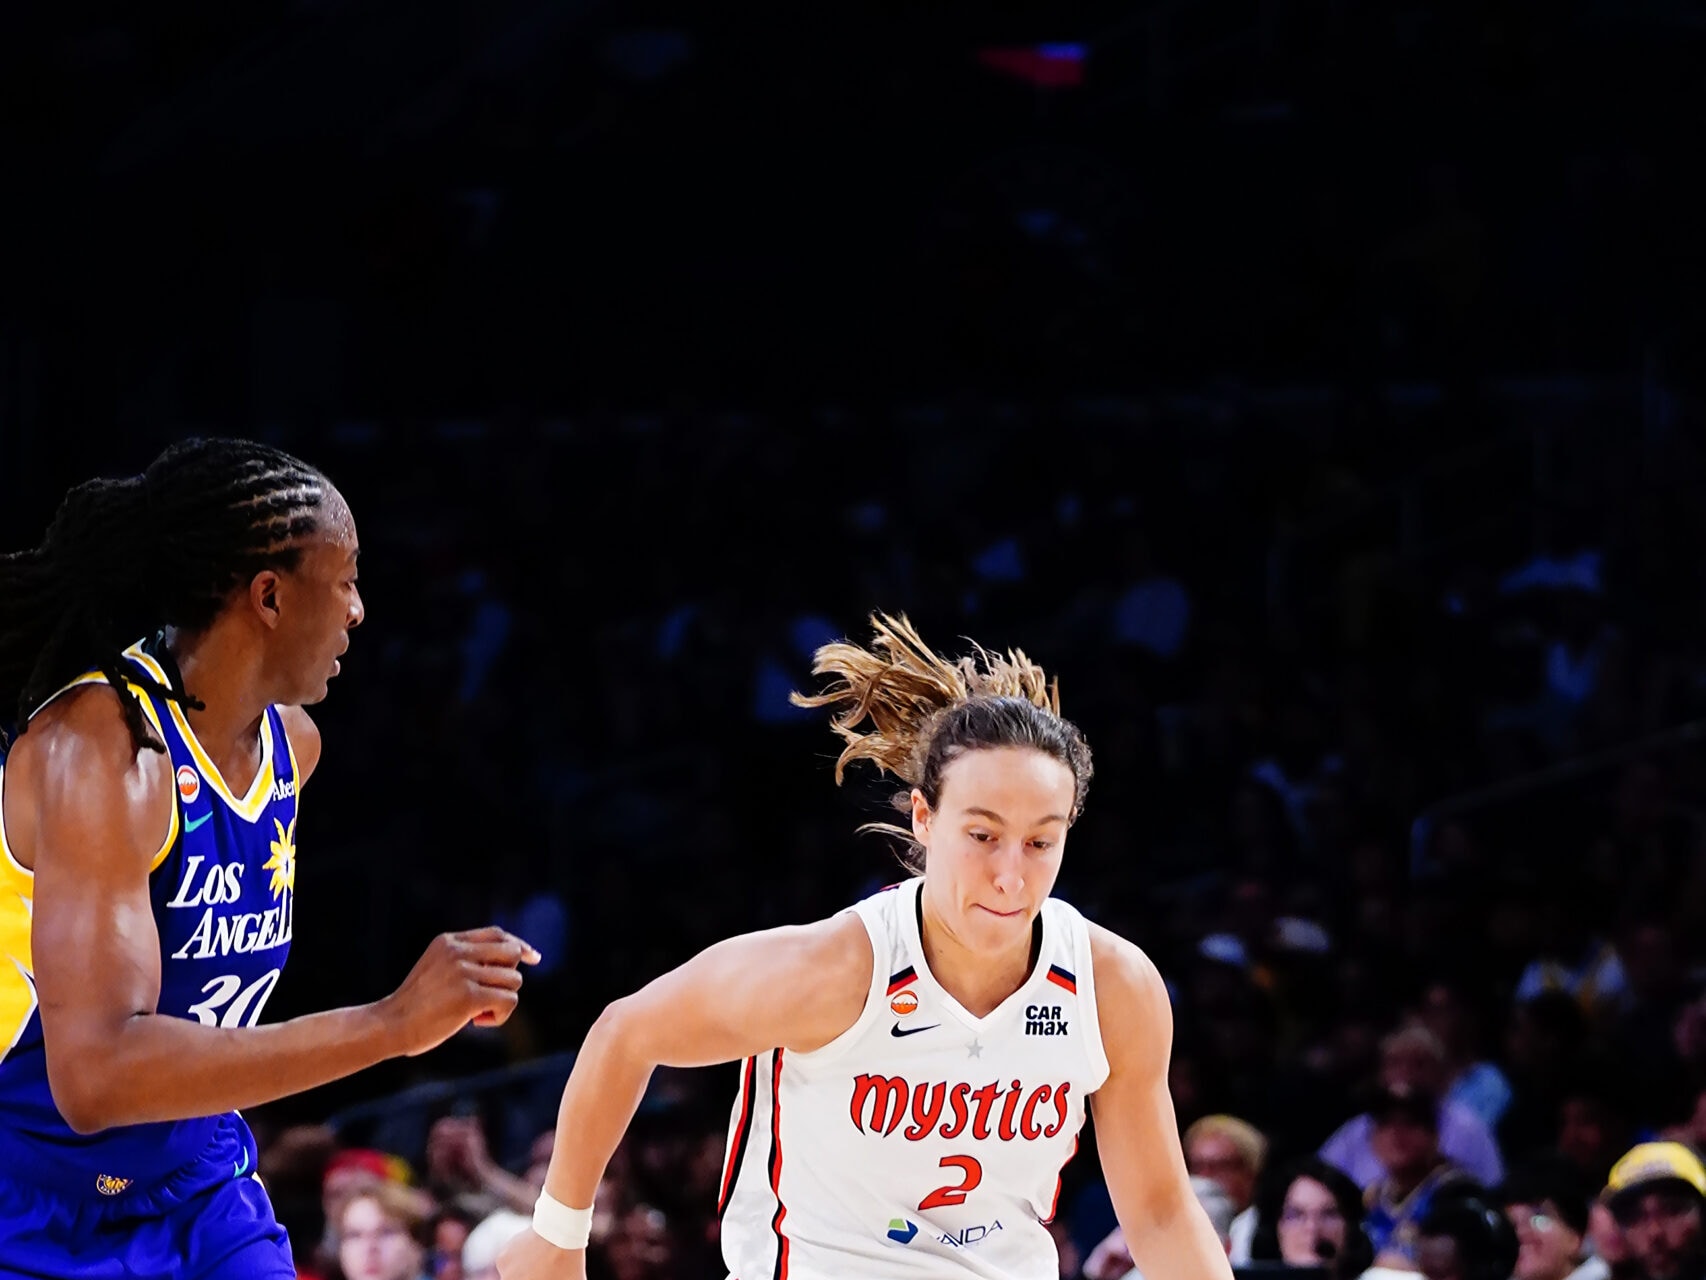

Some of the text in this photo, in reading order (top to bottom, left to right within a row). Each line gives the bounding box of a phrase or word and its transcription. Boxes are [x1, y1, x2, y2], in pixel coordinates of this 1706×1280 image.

[166, 855, 245, 908] LOS
[188, 968, 281, 1029] 30
[1025, 1004, 1062, 1020] CAR
[1025, 1020, 1069, 1036] max
[850, 1073, 1071, 1142] Mystics
[918, 1154, 983, 1211] 2
